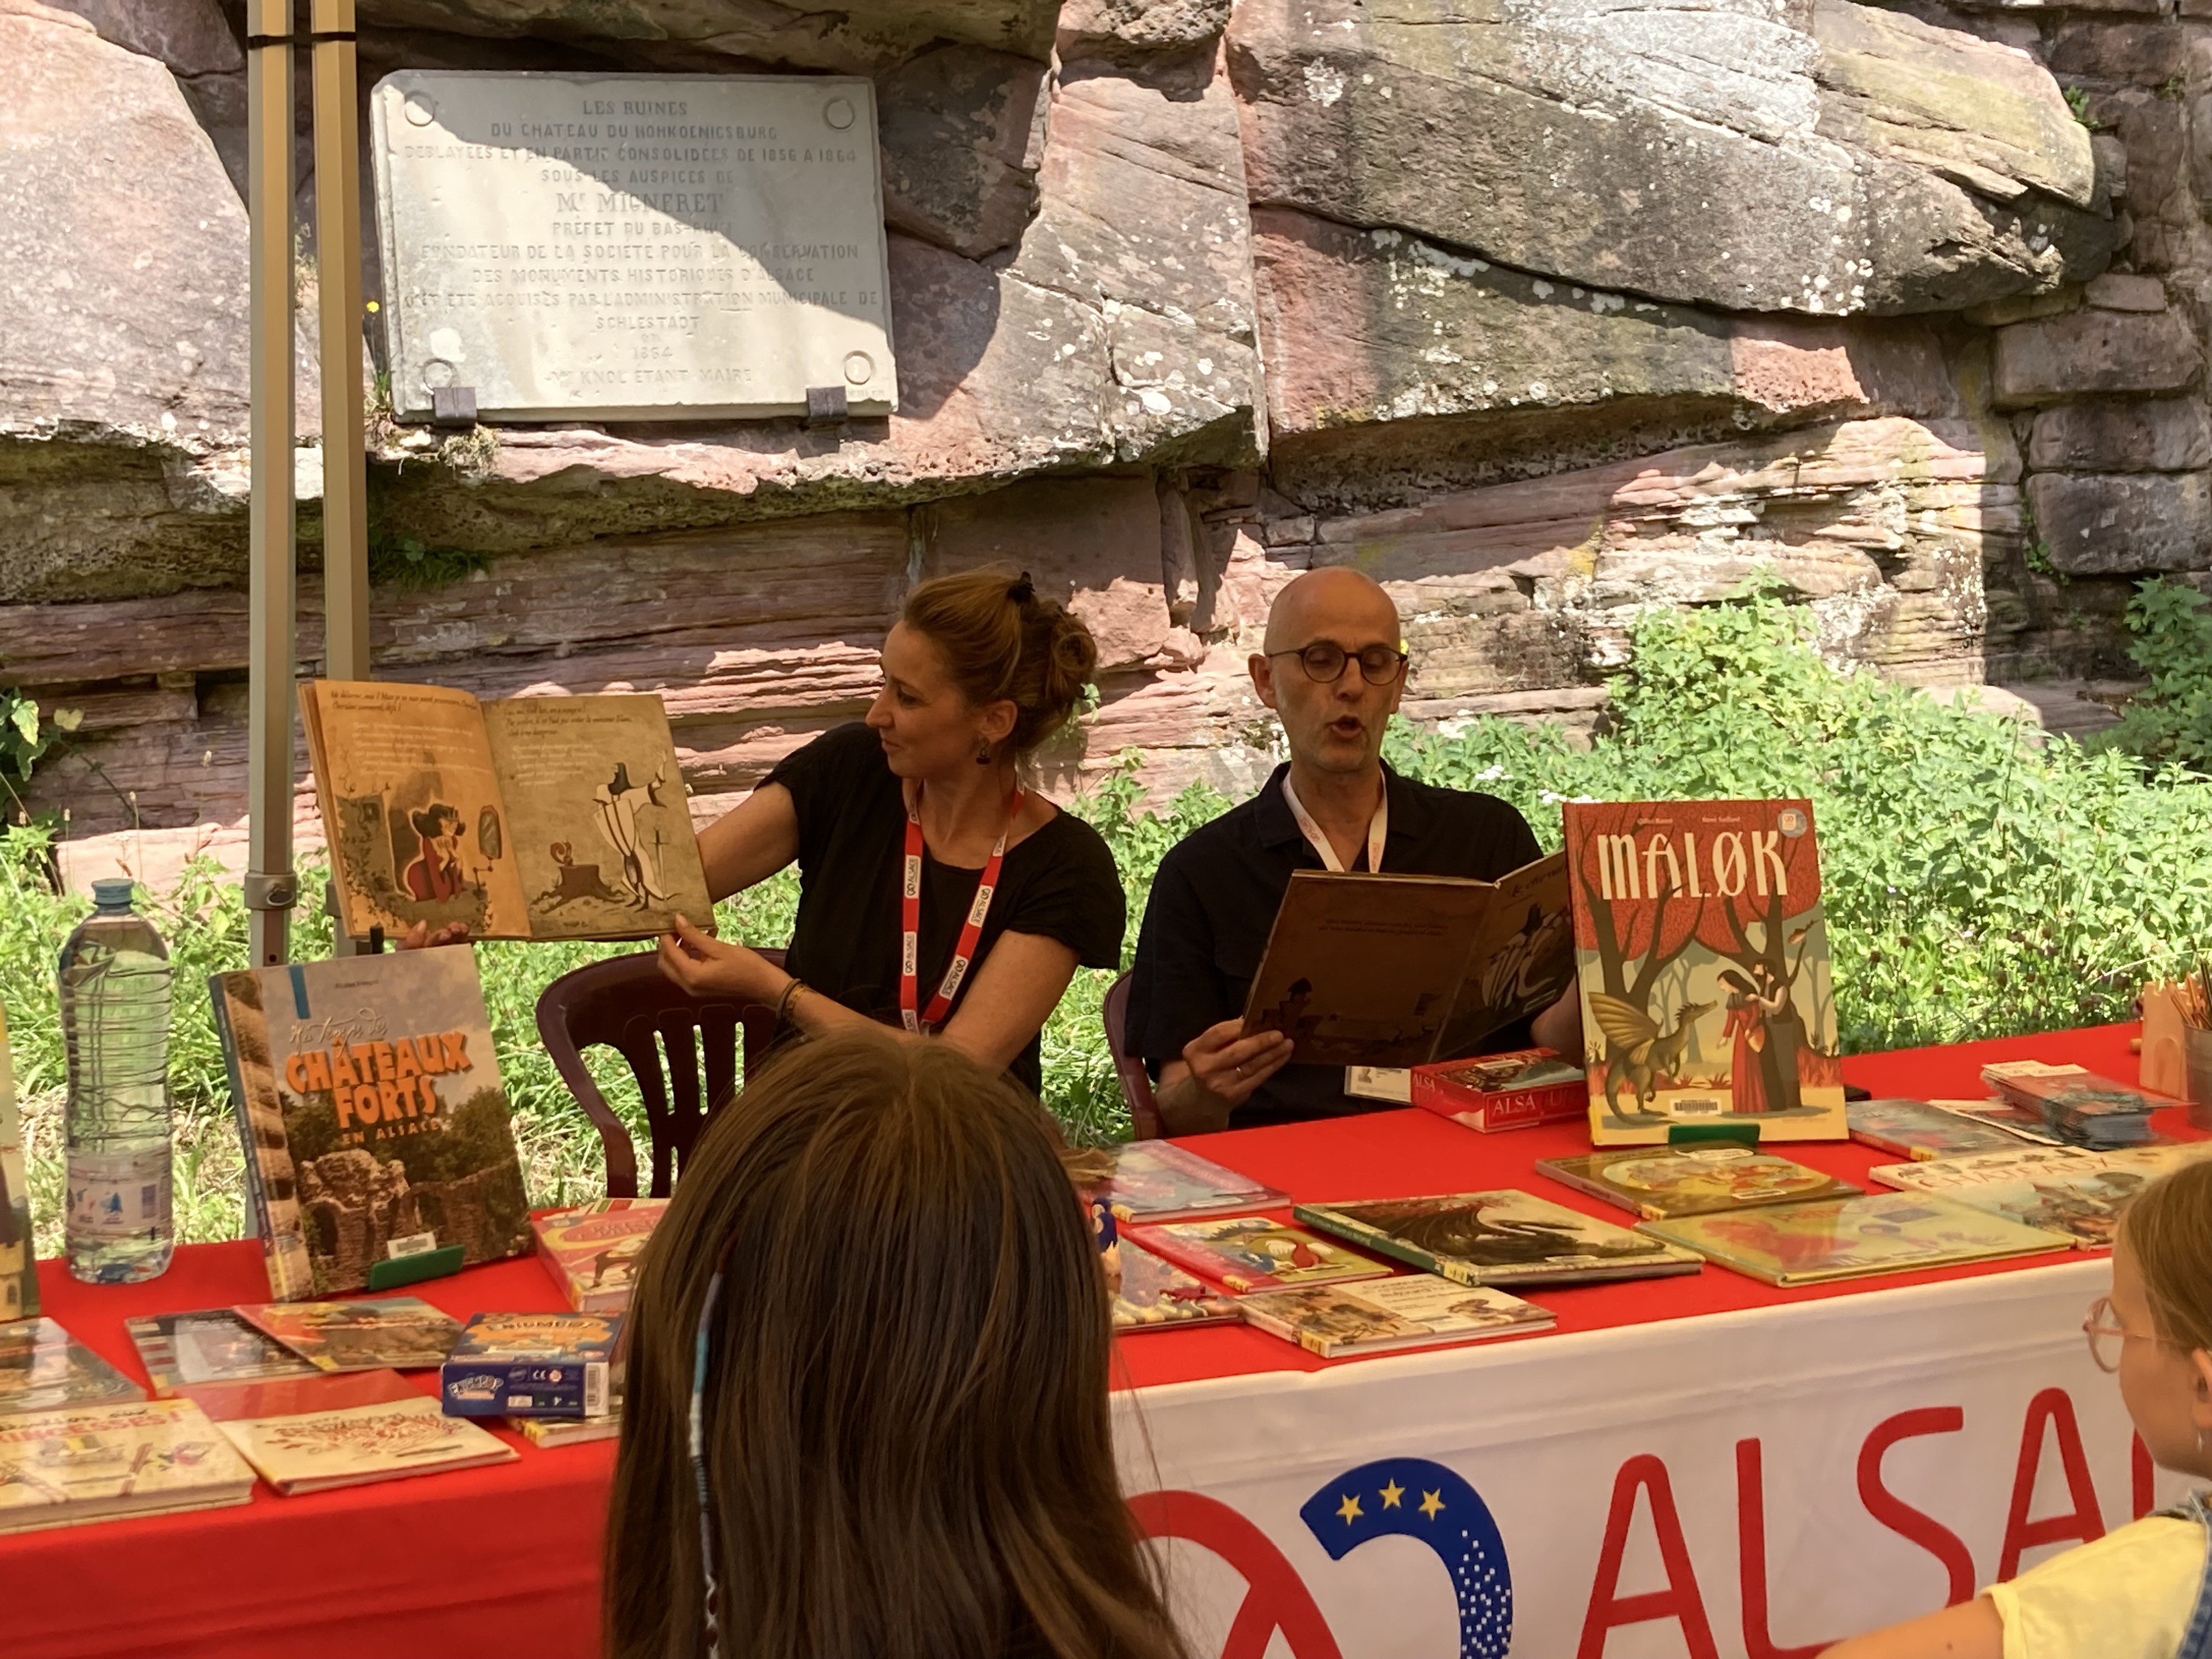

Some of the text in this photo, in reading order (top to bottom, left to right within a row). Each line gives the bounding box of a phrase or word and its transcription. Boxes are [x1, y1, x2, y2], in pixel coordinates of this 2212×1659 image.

[583, 100, 687, 116] LES RUINES
[490, 123, 511, 138] DU
[521, 123, 597, 139] CHATEAU
[606, 124, 628, 139] DU
[500, 146, 518, 160] ET
[525, 146, 546, 161] EN
[554, 146, 608, 161] PARTIE
[737, 148, 755, 162] DE
[763, 149, 797, 162] 1856
[803, 149, 814, 162] A
[819, 149, 857, 163] 1864
[541, 169, 733, 184] SOUS LES AUSPICES DE
[597, 193, 720, 213] MIGNERET
[624, 222, 644, 236] DU
[421, 245, 520, 259] FONDATEUR
[527, 245, 547, 259] DE
[554, 245, 575, 259] LA
[661, 244, 702, 259] POUR
[711, 244, 731, 259] LA
[740, 244, 859, 260] CONSERVATION
[472, 267, 815, 283] DES MONUMENTS HISTORIQUES D'ALSACE
[568, 293, 598, 307] PAR
[759, 291, 848, 307] MUNICIPALE
[859, 291, 878, 306] DE
[596, 316, 701, 330] SCHLESTADT
[699, 369, 752, 383] MAIRE
[285, 1030, 473, 1094] CHÂTEAUX
[334, 1075, 437, 1128] FORTS
[342, 1118, 440, 1145] EN ALSACE
[1577, 1386, 2154, 1659] ALSA
